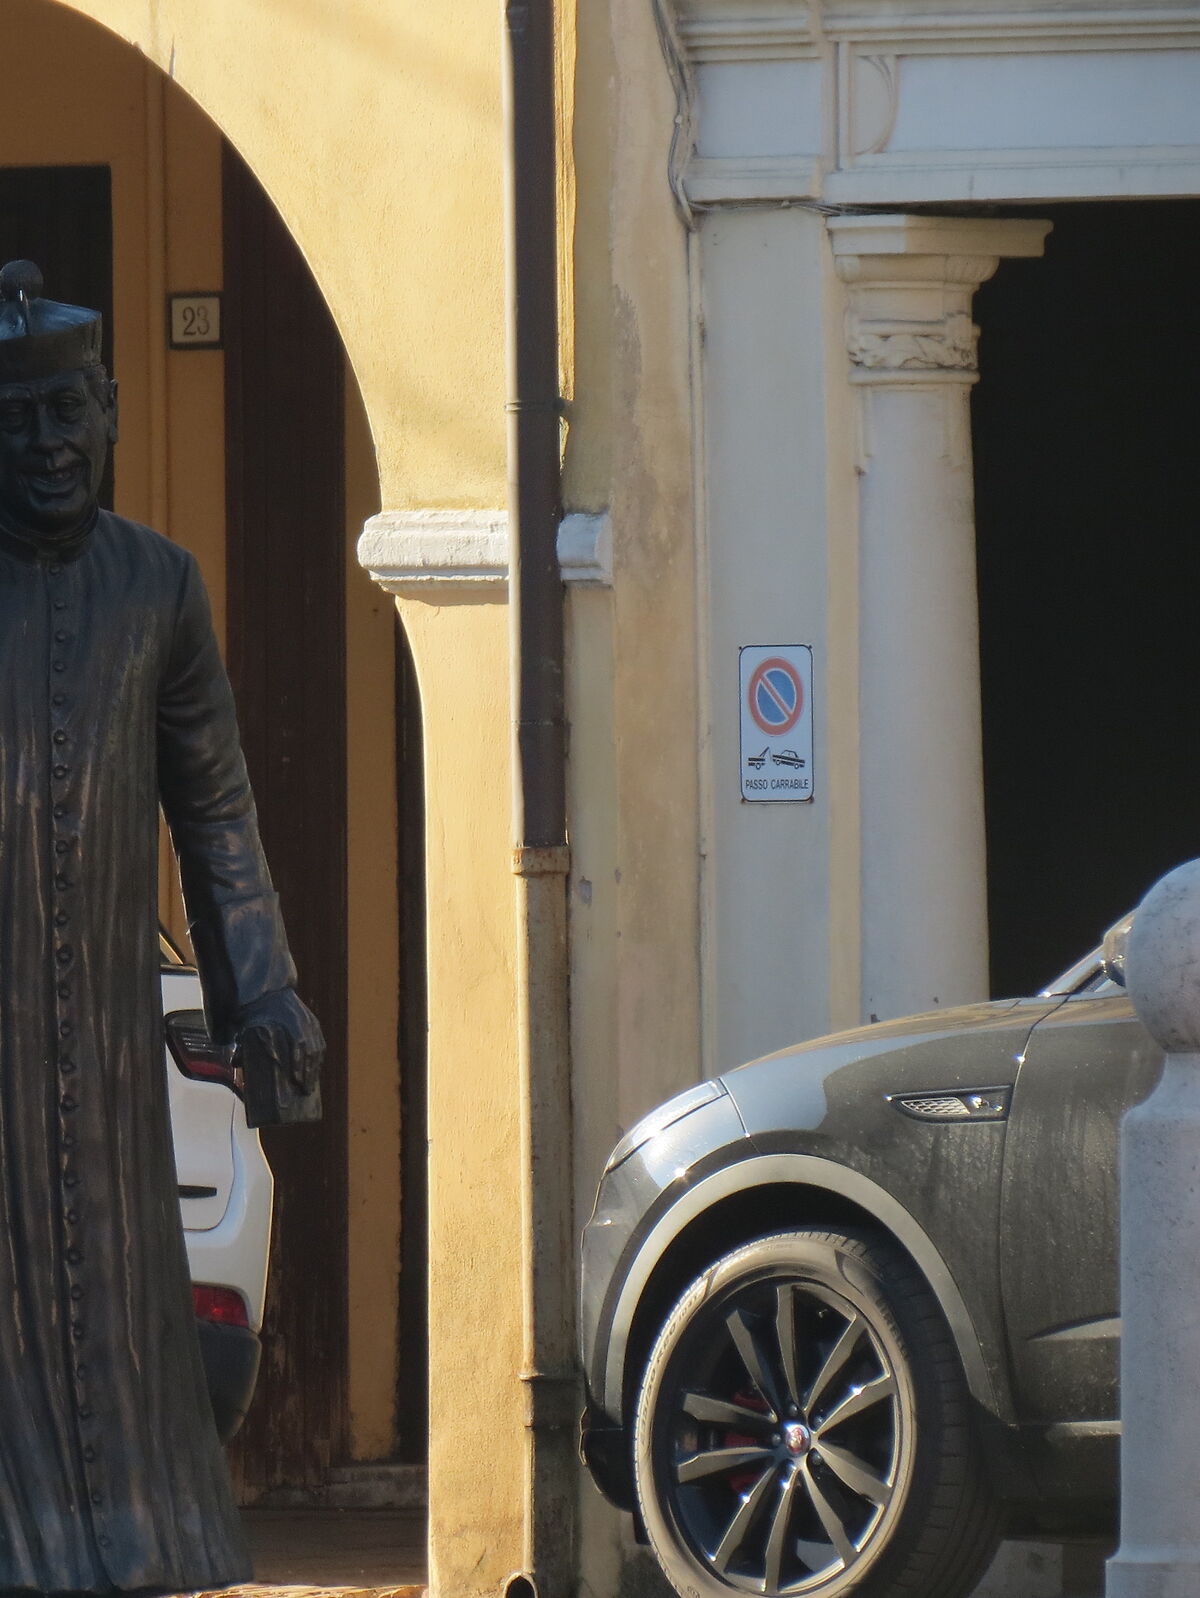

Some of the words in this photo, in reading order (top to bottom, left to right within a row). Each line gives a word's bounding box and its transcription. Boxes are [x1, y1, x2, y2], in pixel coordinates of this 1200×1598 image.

[182, 305, 210, 336] 23
[745, 779, 768, 790] PASSO
[770, 779, 809, 790] CARRABILE
